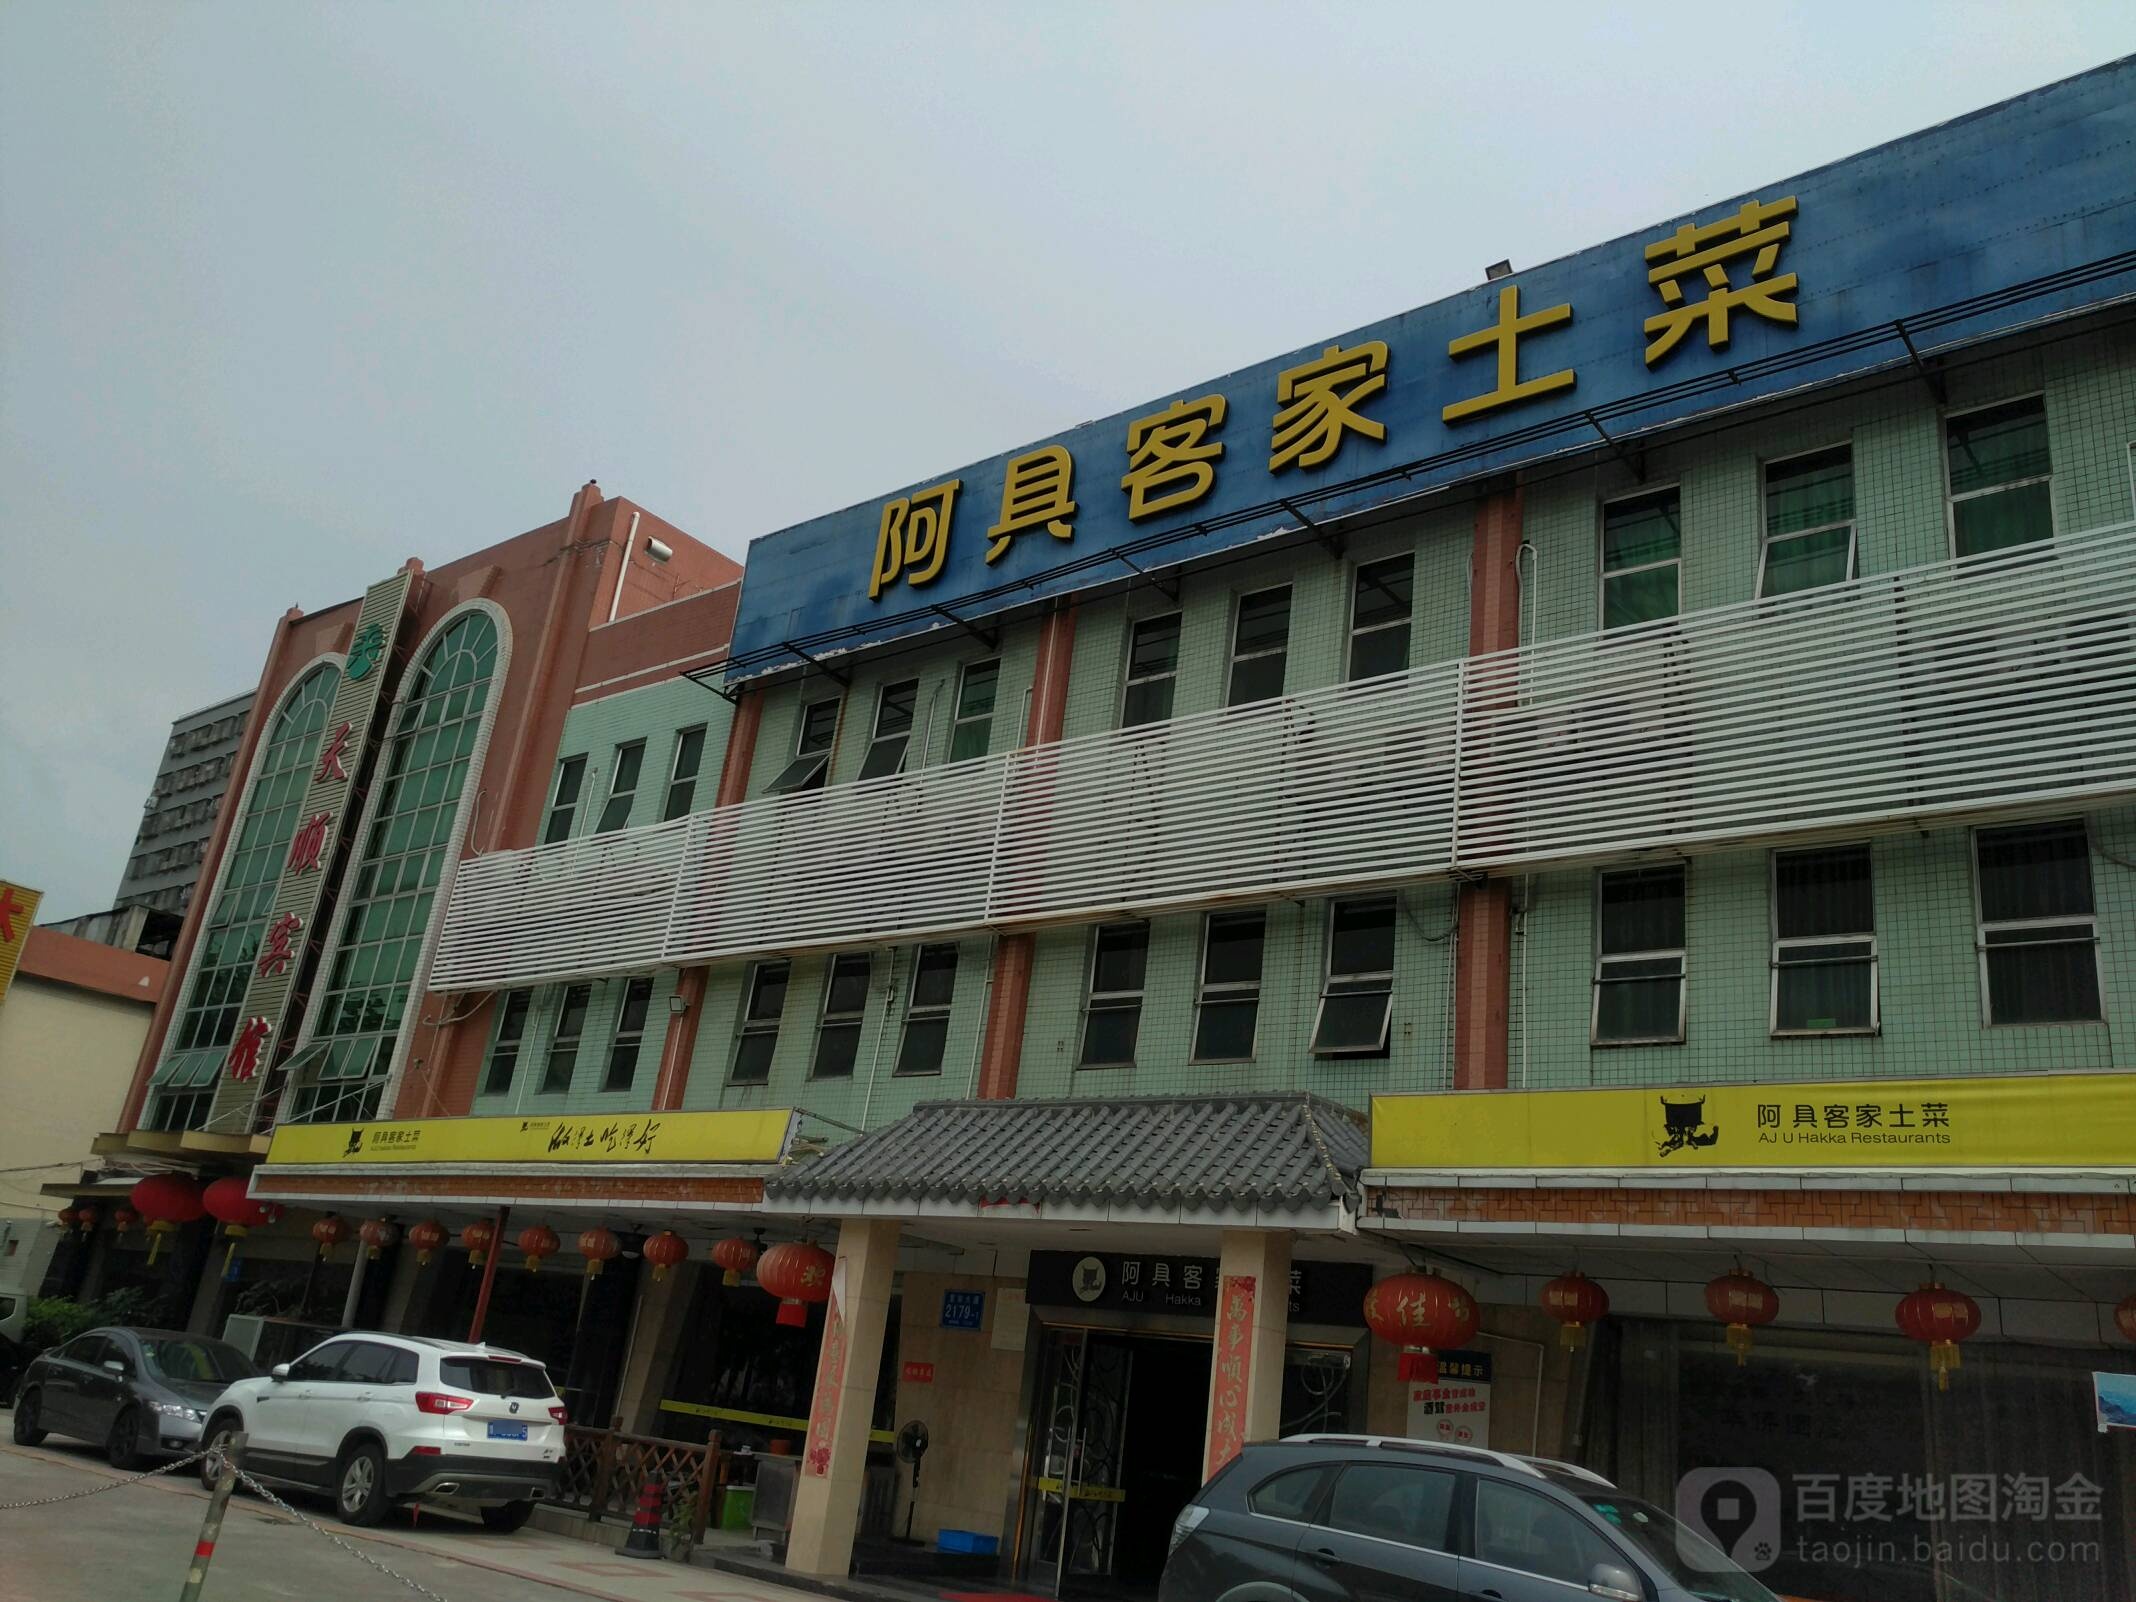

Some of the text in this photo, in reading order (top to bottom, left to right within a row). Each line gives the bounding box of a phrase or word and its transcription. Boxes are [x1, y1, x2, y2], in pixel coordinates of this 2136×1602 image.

[867, 195, 1800, 600] 阿具客家土菜
[1756, 1102, 1951, 1129] 阿具客家土菜
[1798, 1132, 1846, 1144] Hakka
[1851, 1132, 1951, 1144] Restaurants
[1121, 1292, 1202, 1306] AJU Hakka
